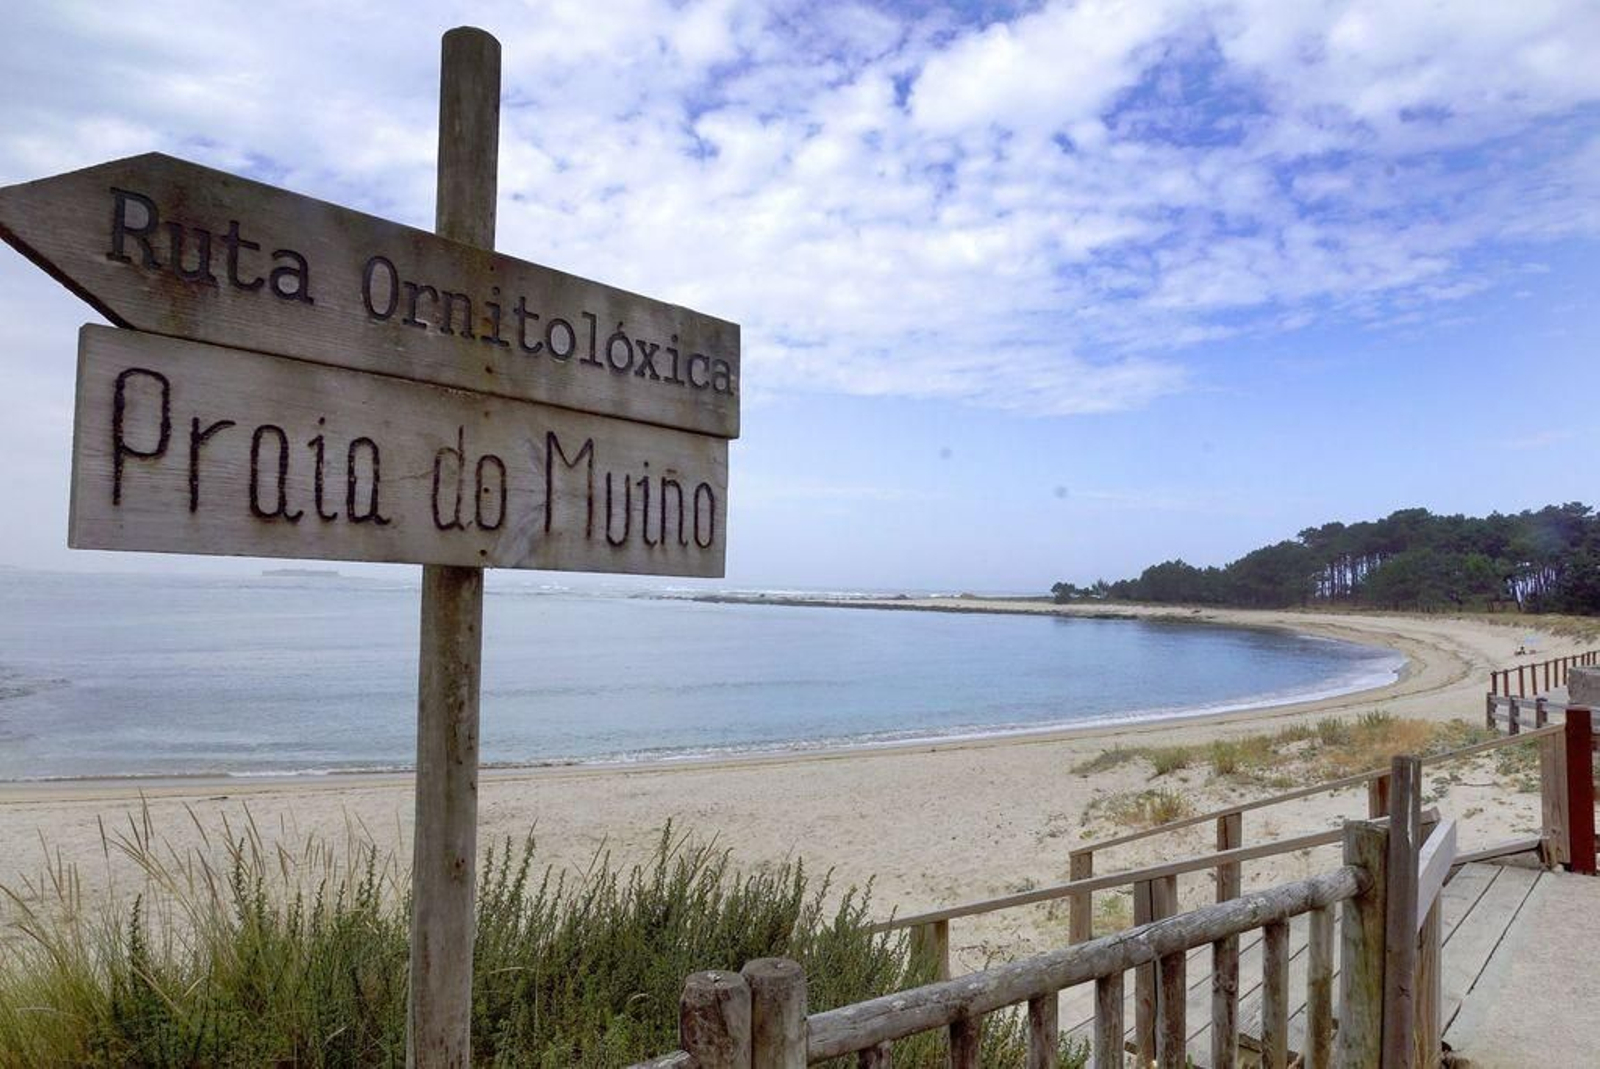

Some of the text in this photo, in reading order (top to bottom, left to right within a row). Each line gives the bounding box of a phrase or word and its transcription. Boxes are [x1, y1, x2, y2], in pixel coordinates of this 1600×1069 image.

[106, 187, 734, 396] Ruta Ornitolóxica
[112, 368, 715, 549] Praia do Muiño
